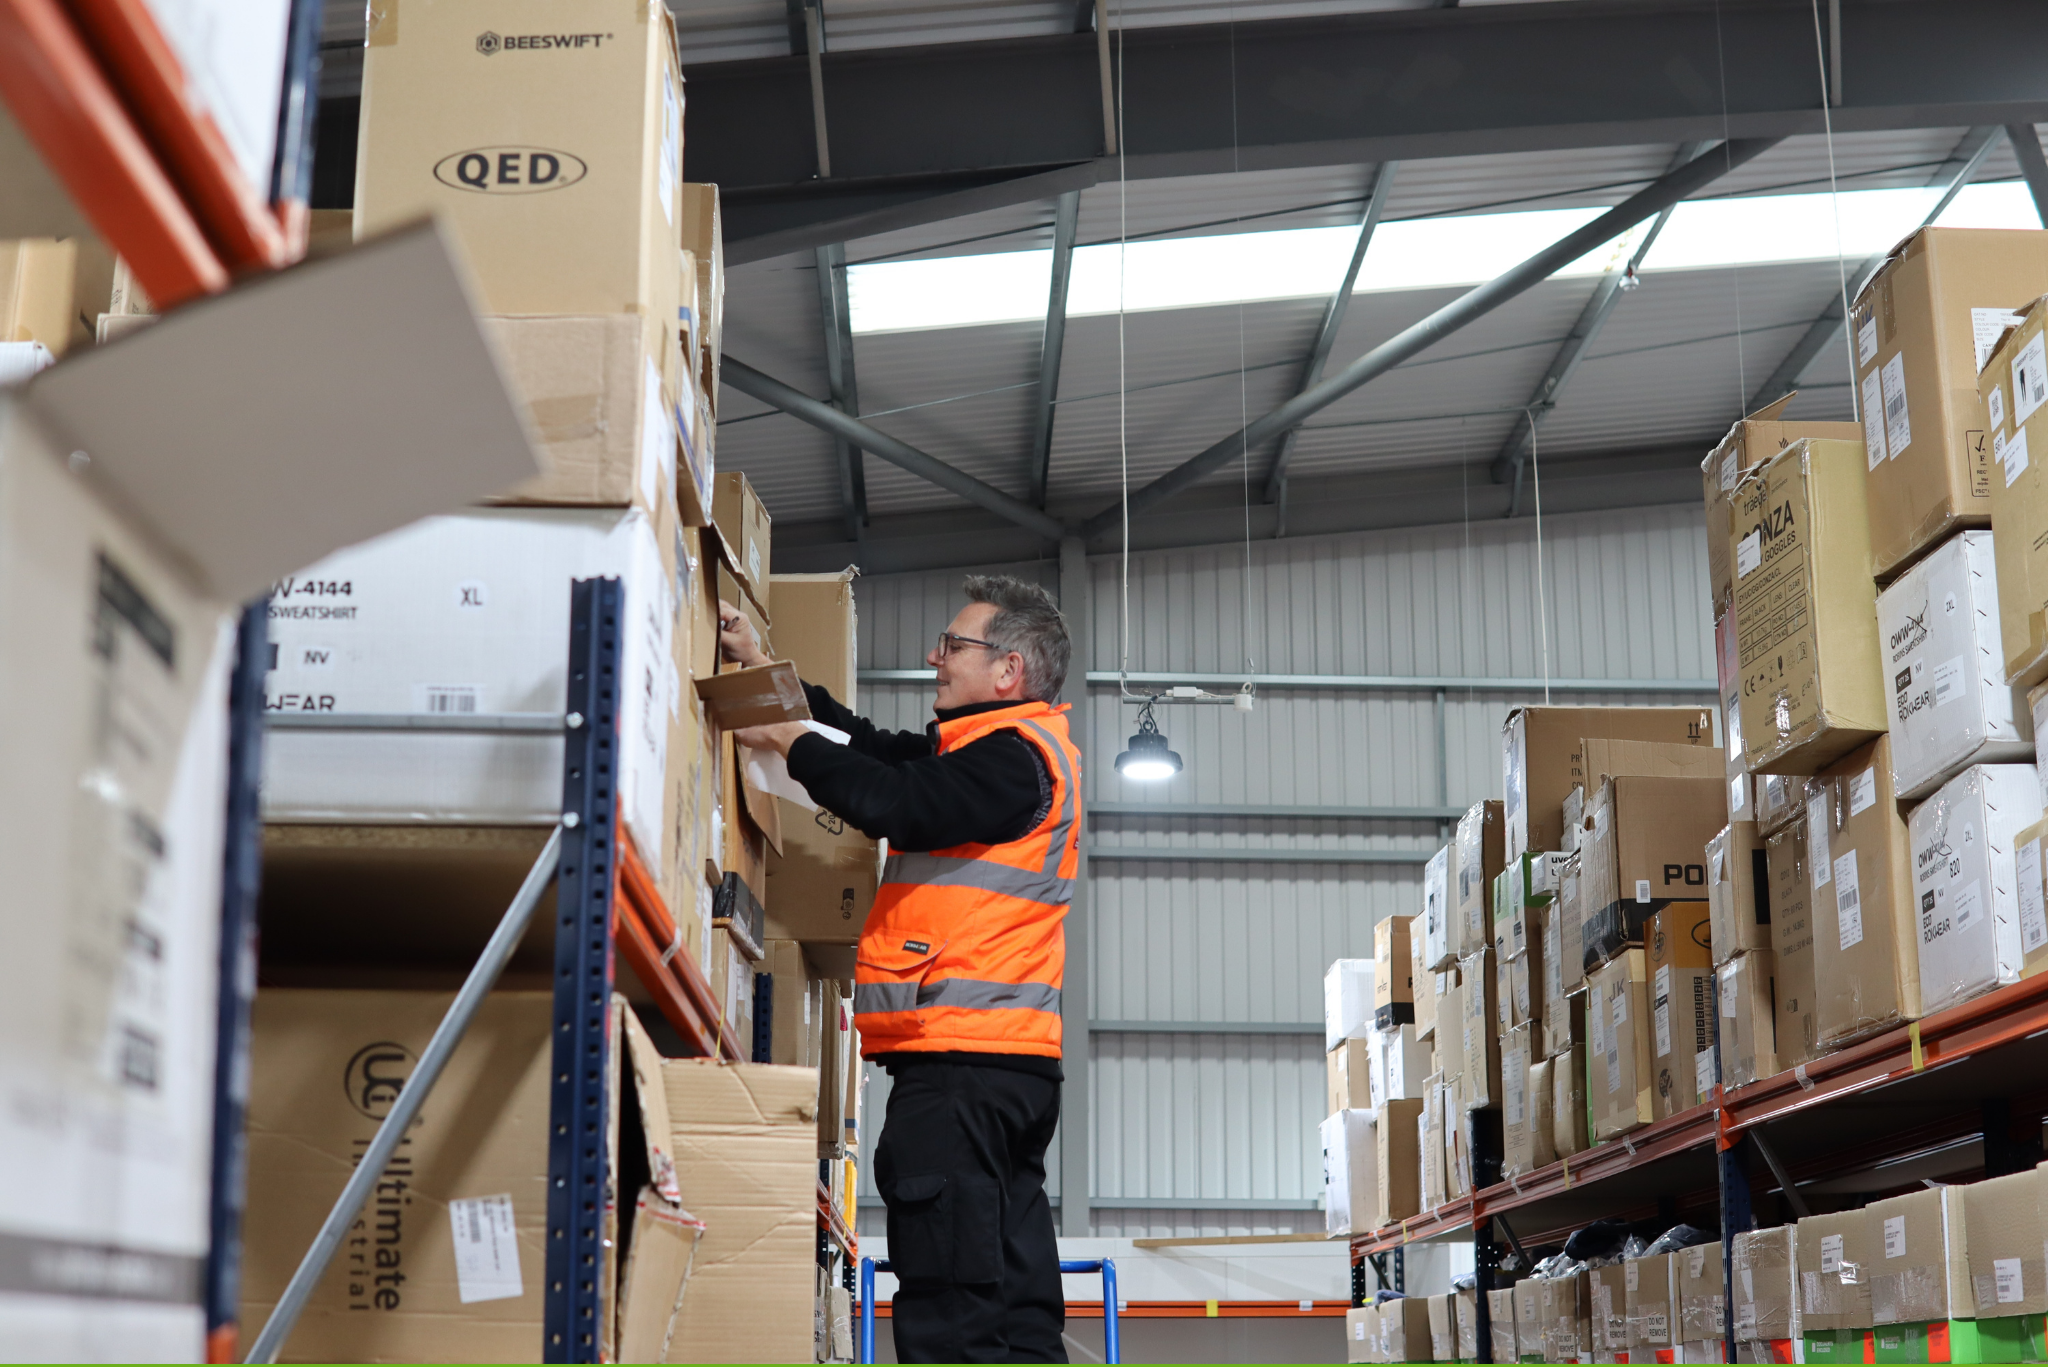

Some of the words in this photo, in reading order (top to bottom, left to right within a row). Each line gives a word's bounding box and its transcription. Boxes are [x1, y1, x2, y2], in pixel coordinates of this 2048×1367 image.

[503, 33, 604, 50] BEESWIFT
[456, 152, 561, 190] QED
[1742, 500, 1795, 547] ONZA
[1765, 530, 1796, 562] GOGGLES
[272, 577, 353, 598] W-4144
[460, 587, 483, 606] XL
[267, 605, 358, 619] SWEATSHIRT
[303, 650, 330, 665] NV
[265, 694, 336, 712] WEAR
[1897, 691, 1908, 708] ECO
[1899, 690, 1930, 723] ROKWEAR
[1571, 754, 1582, 762] PR
[1551, 856, 1569, 864] uve
[1664, 864, 1708, 885] PO
[1609, 978, 1624, 1002] JK
[348, 1139, 371, 1310] Instrial
[1609, 1331, 1626, 1339] REMOVE
[1559, 1345, 1574, 1353] REMOVE
